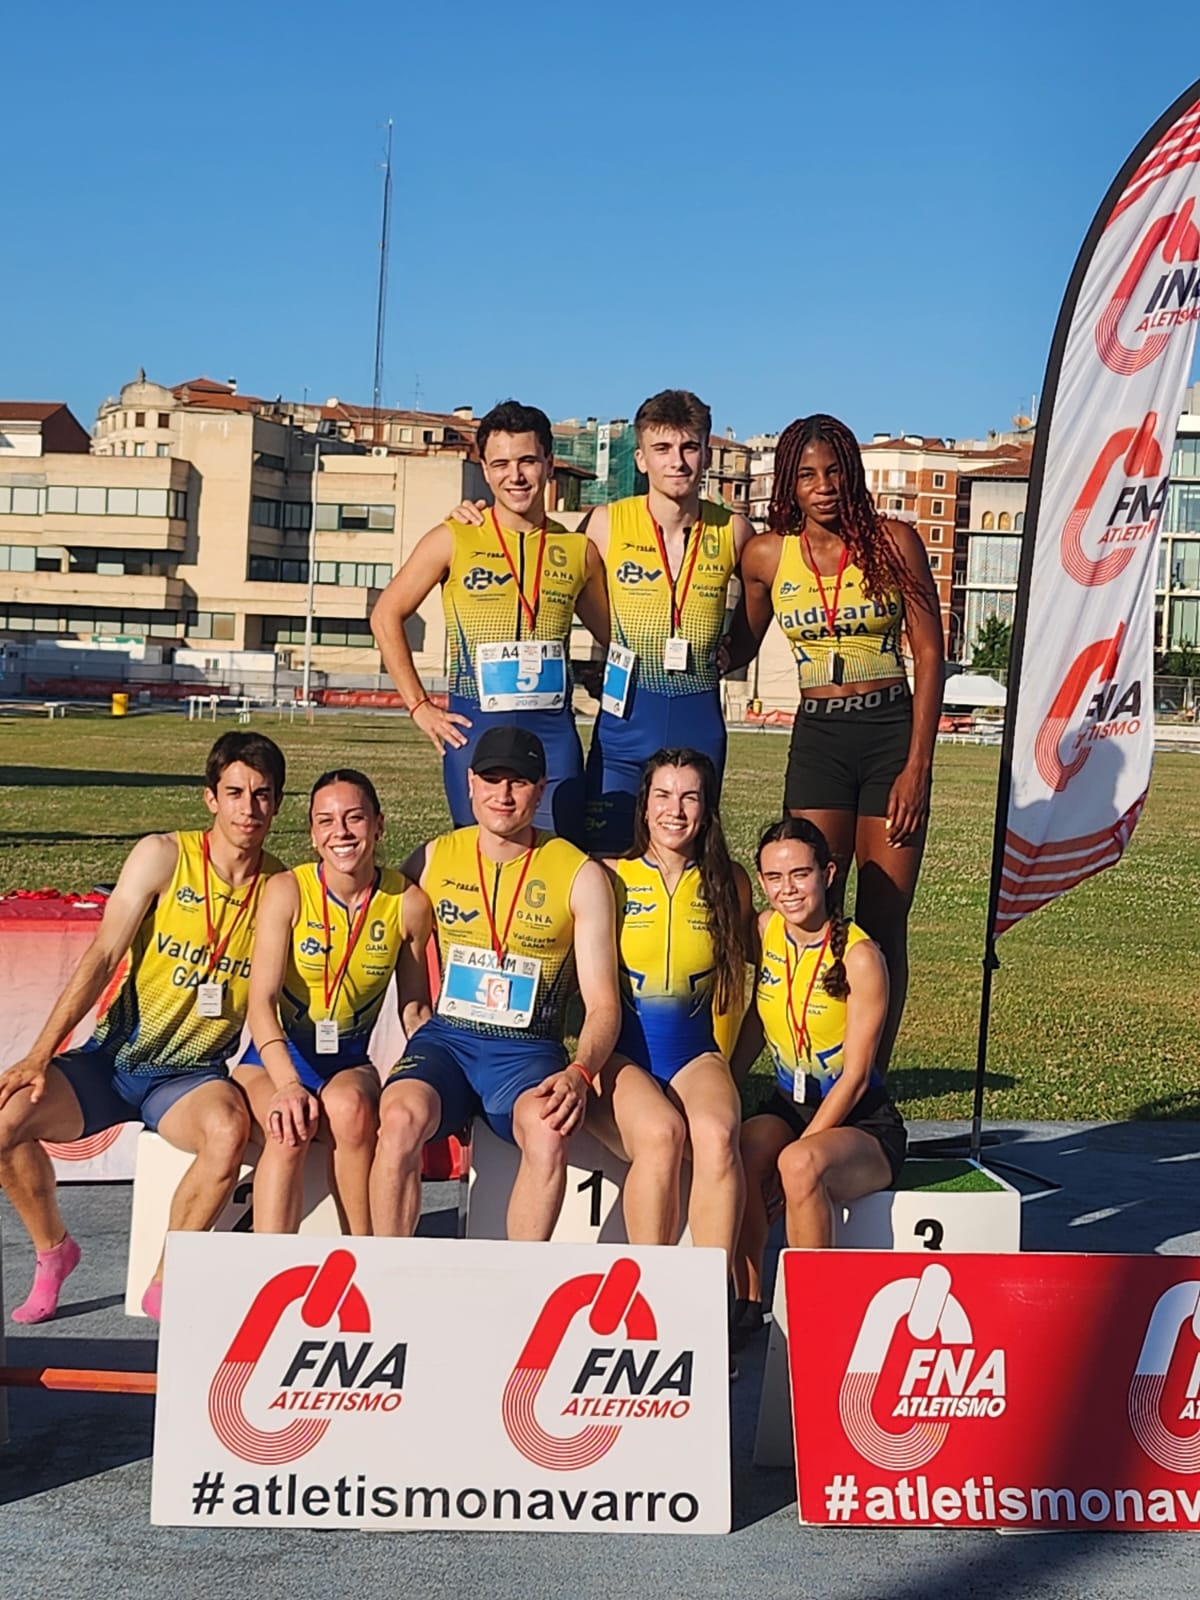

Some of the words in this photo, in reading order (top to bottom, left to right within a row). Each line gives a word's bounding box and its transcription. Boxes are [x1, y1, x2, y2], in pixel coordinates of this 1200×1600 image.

[1106, 476, 1168, 526] FNA
[547, 545, 567, 567] G
[543, 569, 574, 582] GANA
[825, 691, 882, 714] PRO
[524, 879, 546, 909] G
[516, 910, 553, 925] GANA
[370, 920, 385, 942] G
[158, 932, 252, 979] Valdiarb
[365, 944, 388, 952] GANA
[521, 941, 546, 950] GANA
[468, 951, 517, 973] A4XM
[577, 1170, 604, 1227] 1
[280, 1340, 408, 1390] FNA
[571, 1348, 694, 1397] FNA
[899, 1349, 1006, 1397] FNA
[268, 1391, 403, 1412] ATLETISMO
[560, 1398, 691, 1419] ATLETISMO
[891, 1397, 1006, 1418] ATLETISMO
[192, 1471, 700, 1524] #atletismonavarro
